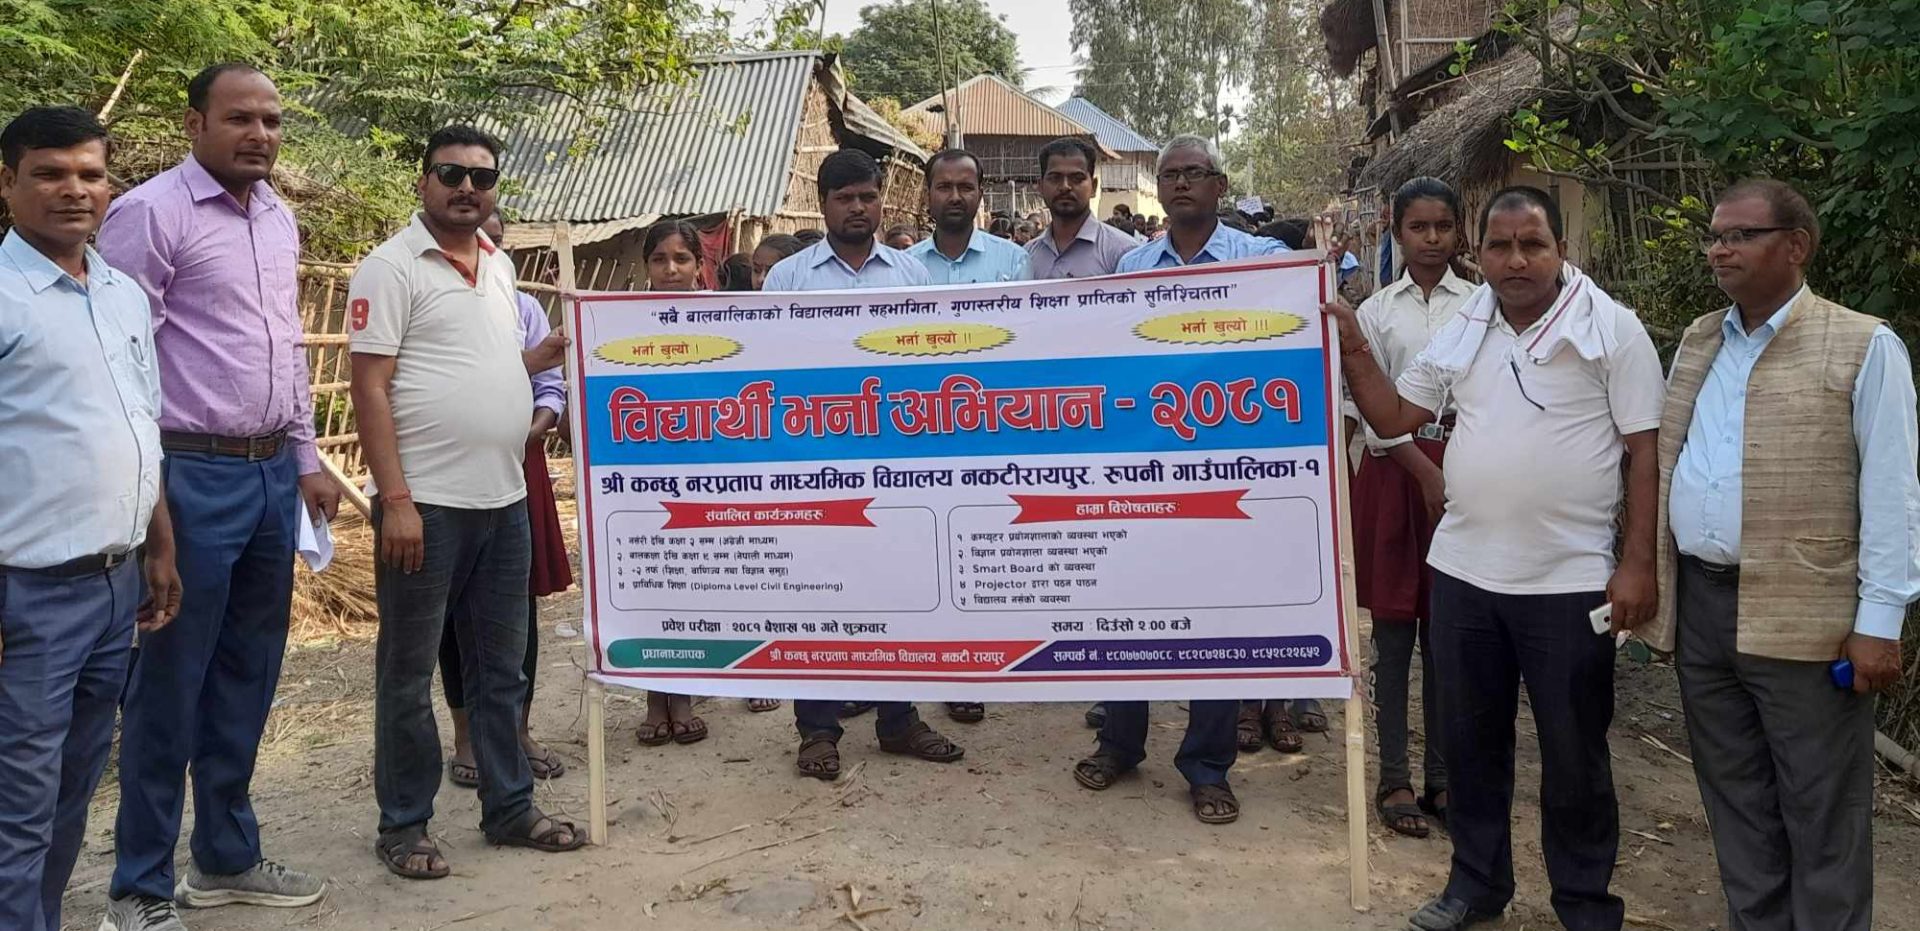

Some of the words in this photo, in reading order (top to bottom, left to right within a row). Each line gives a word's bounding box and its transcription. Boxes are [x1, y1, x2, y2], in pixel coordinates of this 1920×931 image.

[686, 305, 782, 323] बालबालिकाको
[789, 302, 862, 319] विद्यालयमा
[869, 298, 941, 318] सहभागिता,
[951, 294, 1023, 317] गुणस्तरीय
[1030, 292, 1070, 311] शिक्षा
[1078, 288, 1137, 308] प्राप्तिको
[351, 298, 370, 331] 9
[1181, 319, 1206, 335] भर्ना
[1213, 317, 1248, 337] खुल्यो
[896, 330, 920, 346] भर्ना
[925, 330, 957, 349] खुल्यो
[632, 341, 655, 357] भर्ना
[660, 340, 690, 360] खुल्यो
[608, 380, 776, 443] विद्यार्थी
[782, 376, 882, 438] भर्ना
[888, 374, 1107, 436] अभियान
[1148, 377, 1302, 441] २०८१
[601, 472, 625, 495] श्री
[686, 474, 764, 494] नरप्रताप
[770, 467, 867, 491] माध्यमिक
[872, 465, 954, 489] विद्यालय
[1075, 502, 1105, 516] हाम्रा
[972, 563, 1007, 574] Smart
[1010, 563, 1044, 574] Board
[690, 581, 732, 593] (Diploma
[734, 581, 758, 591] Level
[760, 581, 781, 591] Civil
[784, 581, 843, 593] Engineering)
[974, 580, 1027, 592] Projector
[661, 618, 686, 632] प्रवेश
[689, 618, 721, 633] परीक्षा
[732, 621, 761, 633] २०८१
[764, 619, 798, 633] बैशाख
[801, 622, 816, 632] १४
[820, 620, 839, 634] गते
[842, 622, 888, 636] शुक्रवार
[1051, 621, 1084, 633] समय
[1170, 616, 1192, 631] बजे
[641, 648, 706, 661] प्रधानाध्यापक
[769, 648, 781, 662] श्री
[811, 650, 848, 662] नरप्रताप
[851, 648, 896, 663] माध्यमिक
[942, 648, 970, 663] नकटी
[973, 651, 1005, 665] रायपुर
[1053, 648, 1086, 662] सम्पर्क
